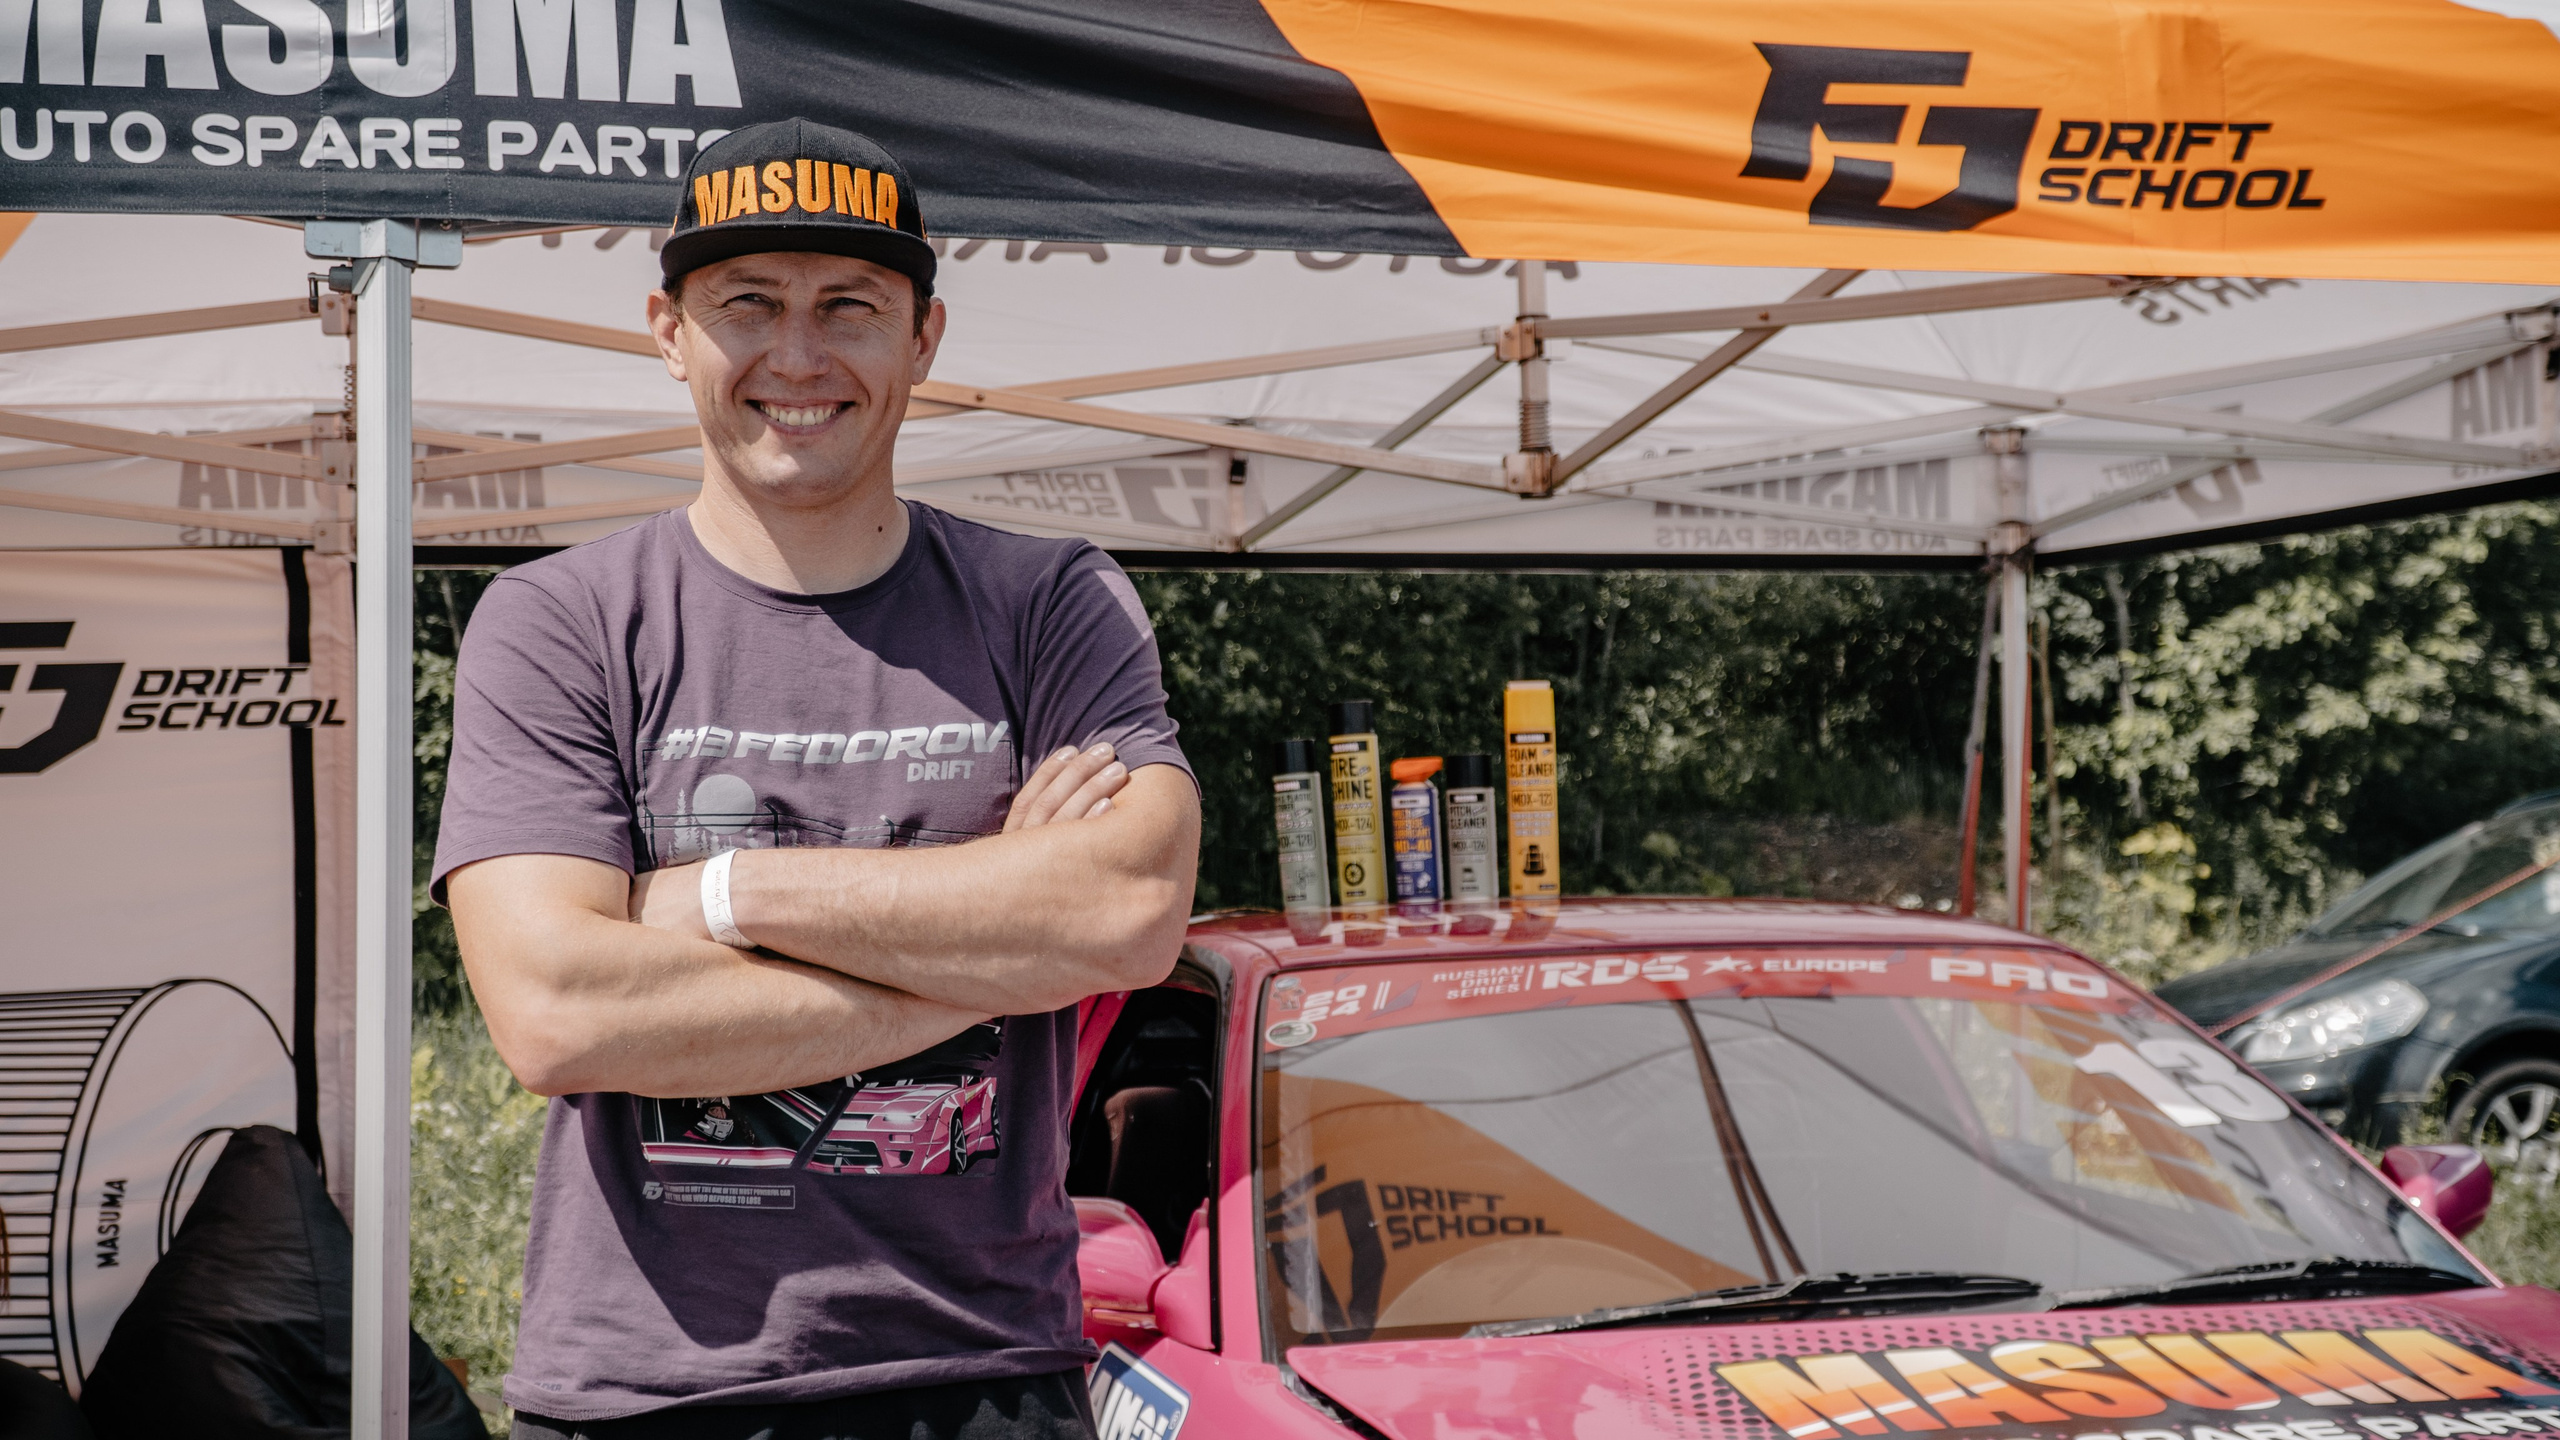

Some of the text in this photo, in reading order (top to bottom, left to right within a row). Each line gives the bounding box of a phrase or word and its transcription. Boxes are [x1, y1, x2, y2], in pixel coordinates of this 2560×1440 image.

[0, 107, 167, 163] UTO
[192, 113, 465, 169] SPARE
[2048, 121, 2271, 163] DRIFT
[694, 159, 898, 230] MASUMA
[2038, 168, 2326, 210] SCHOOL
[133, 667, 310, 697] DRIFT
[118, 700, 346, 731] SCHOOL
[734, 721, 1009, 764] FEDOROV
[1510, 748, 1537, 761] FOAM
[907, 760, 975, 782] DRIFT
[1331, 758, 1359, 778] TIRE
[1510, 762, 1554, 777] CLEANER
[1433, 965, 1525, 984] RUSSIAN
[1461, 974, 1520, 990] DRIFT
[1540, 955, 1888, 990] RDS EUROPE
[1930, 957, 2108, 998] PRO
[1303, 984, 1368, 1009] 20
[1446, 983, 1520, 1000] SERIES
[2074, 1039, 2291, 1127] 13
[708, 1195, 737, 1204] REFUSES
[737, 1196, 746, 1204] TO
[746, 1196, 762, 1205] LOSE
[1378, 1184, 1505, 1214] DRIFT
[96, 1178, 129, 1270] MASUMA
[1385, 1215, 1563, 1250] SCHOOL
[1715, 1328, 2560, 1440] MASUMA
[2356, 1409, 2560, 1440] PART
